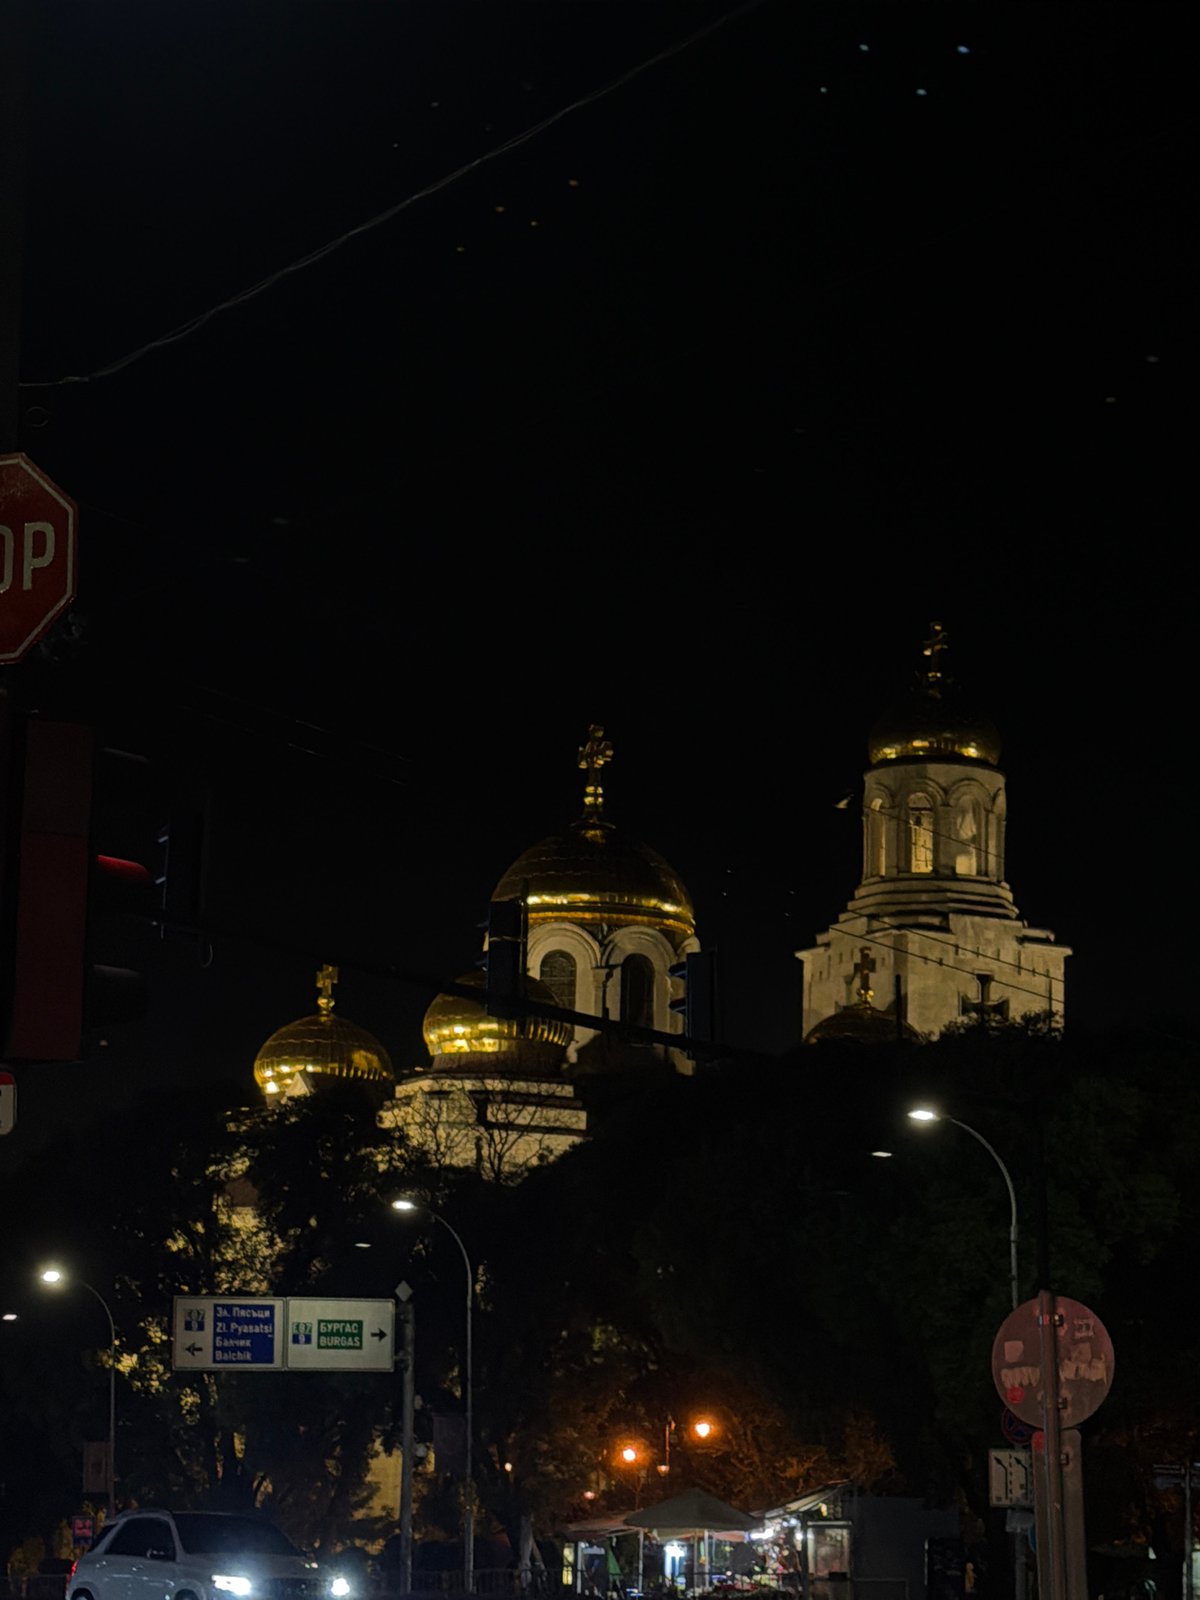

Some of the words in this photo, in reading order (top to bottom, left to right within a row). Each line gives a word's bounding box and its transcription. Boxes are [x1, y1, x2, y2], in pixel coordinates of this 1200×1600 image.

[319, 1322, 359, 1333] БУРГАС
[319, 1336, 361, 1348] BURGAS
[216, 1350, 253, 1362] Balchik
